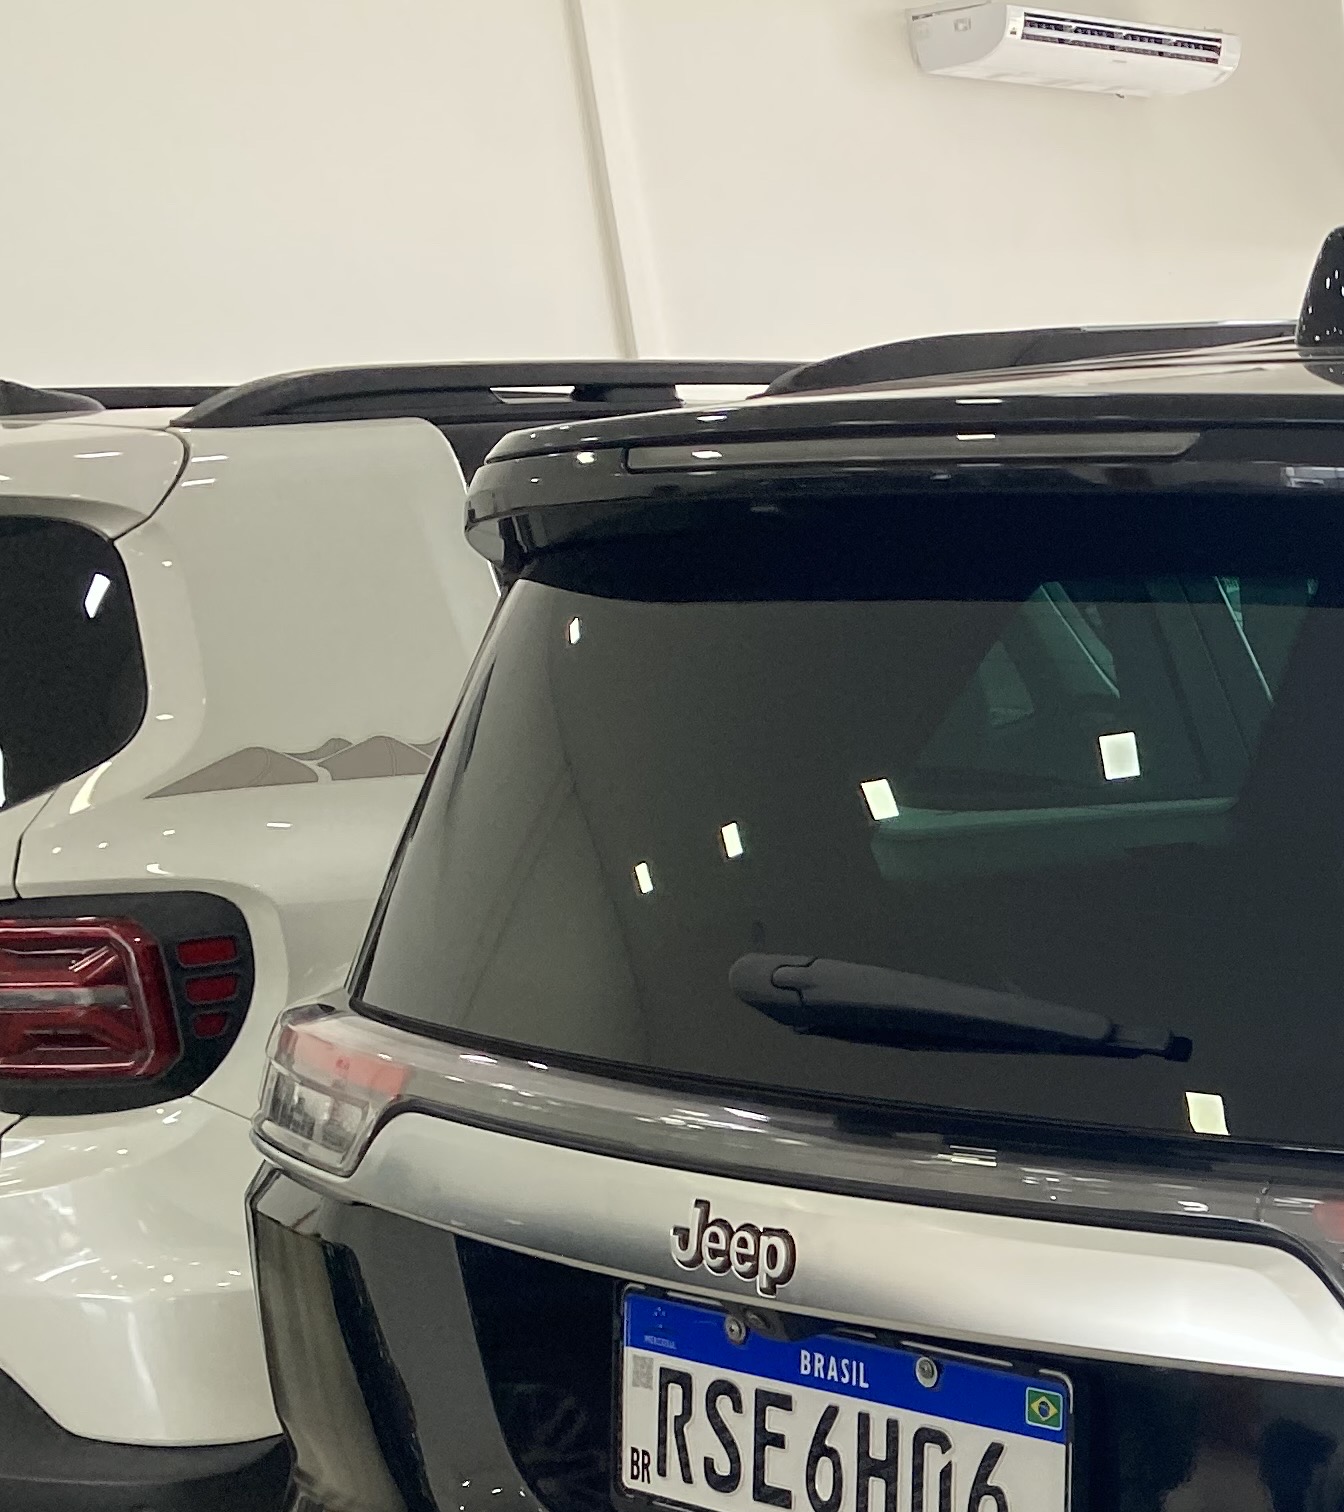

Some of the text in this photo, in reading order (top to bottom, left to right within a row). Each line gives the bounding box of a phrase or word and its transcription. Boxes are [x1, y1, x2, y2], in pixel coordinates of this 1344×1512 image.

[670, 1198, 796, 1298] Jeep
[800, 1349, 870, 1389] BRASIL
[630, 1446, 651, 1485] BR
